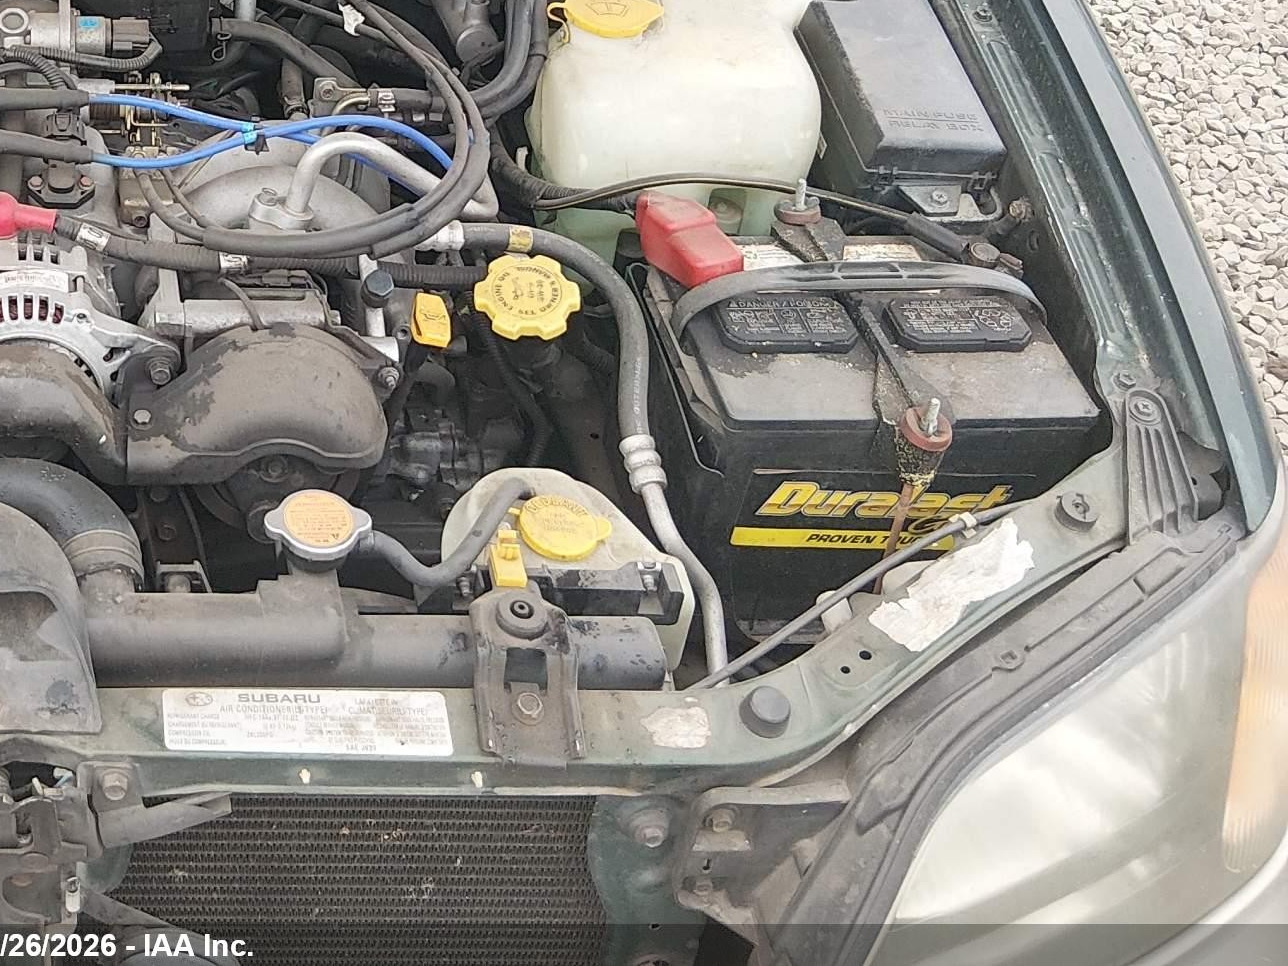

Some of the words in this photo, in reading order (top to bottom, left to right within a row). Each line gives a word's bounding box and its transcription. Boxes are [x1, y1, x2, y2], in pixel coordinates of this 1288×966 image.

[805, 533, 878, 545] PROVEN
[237, 692, 321, 704] SUBARU
[219, 704, 234, 714] AIR
